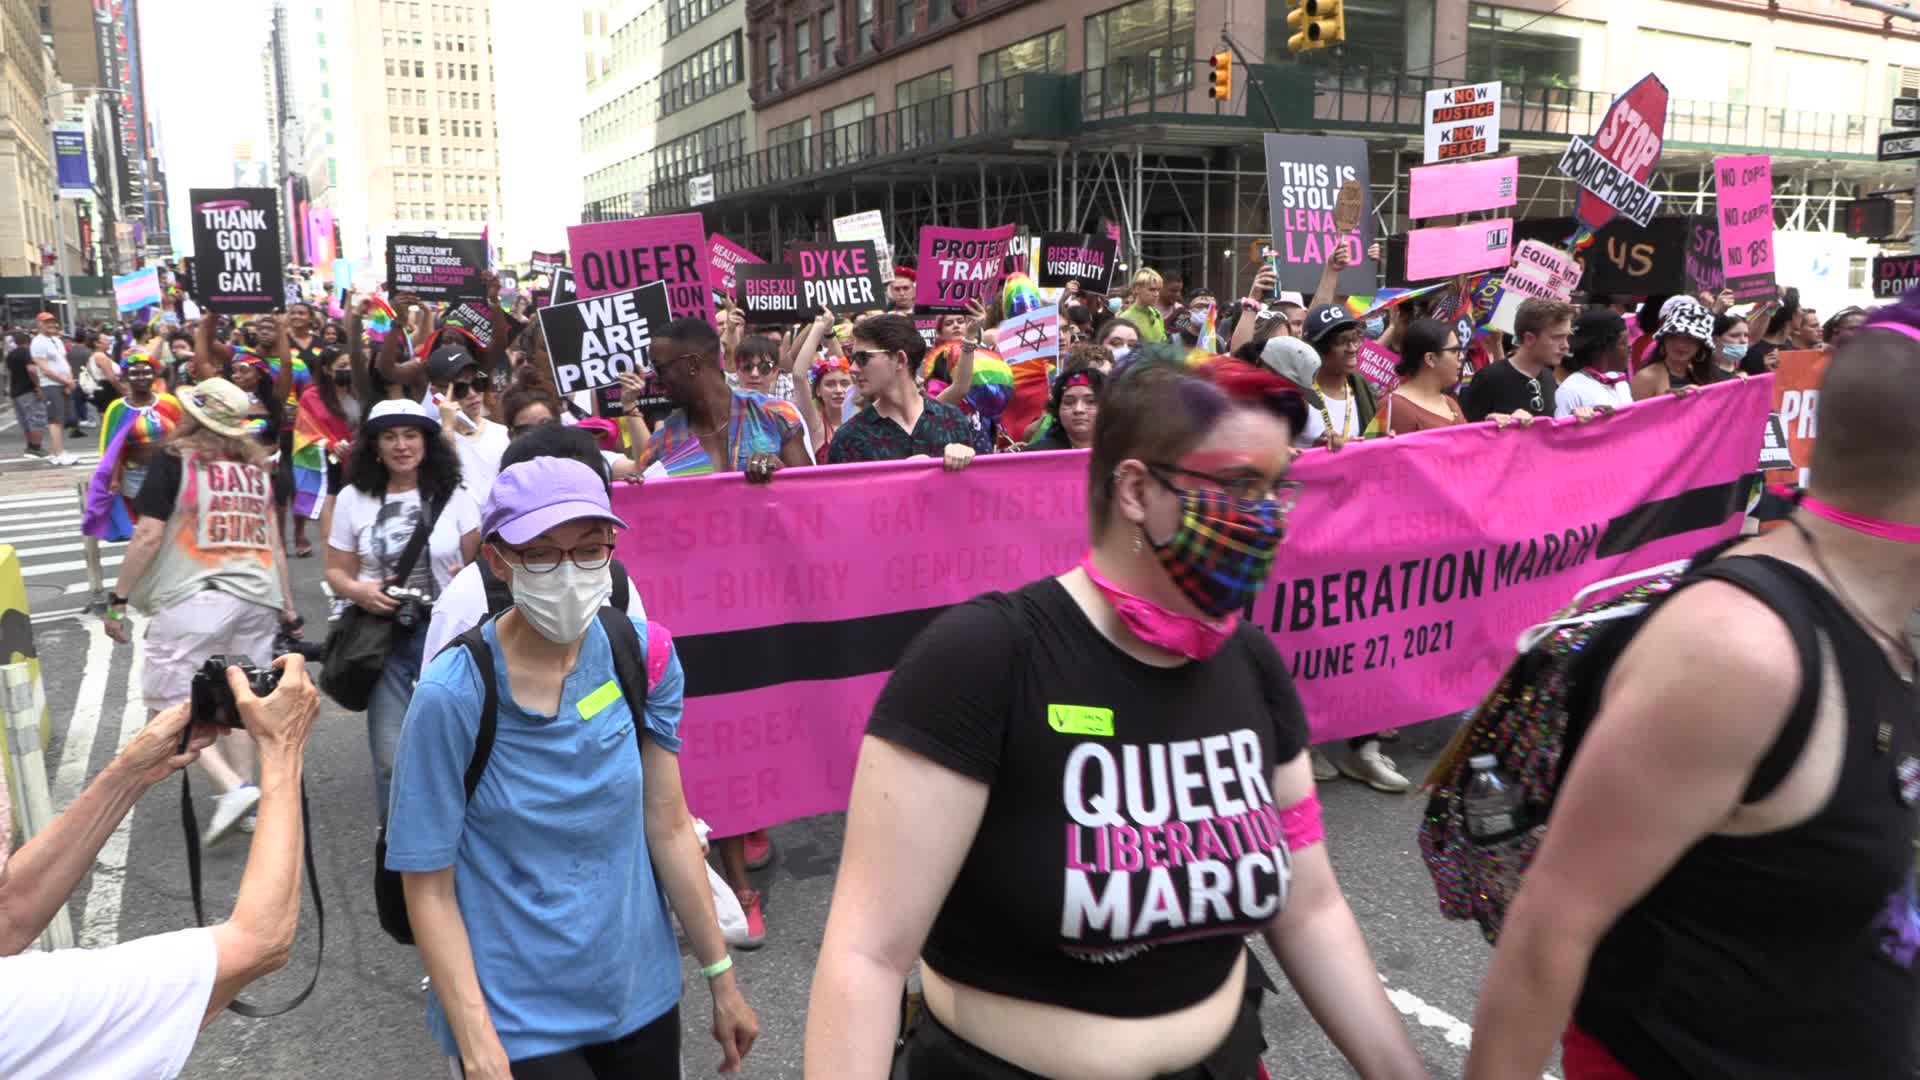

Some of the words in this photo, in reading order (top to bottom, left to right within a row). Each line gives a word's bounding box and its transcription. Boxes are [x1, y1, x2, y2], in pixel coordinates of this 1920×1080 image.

[1433, 102, 1494, 122] JUSTICE
[1439, 140, 1486, 159] PEACE
[1599, 100, 1660, 176] STOP
[1280, 162, 1329, 187] THIS
[1335, 165, 1356, 188] IS
[1561, 139, 1657, 226] HOMOPHOBIA
[1722, 168, 1736, 187] NO
[1281, 185, 1341, 210] STOL
[201, 208, 267, 229] THANK
[1724, 208, 1739, 226] NO
[216, 230, 256, 250] GOD
[224, 251, 252, 272] I'M
[582, 244, 700, 291] QUEER
[800, 248, 869, 278] DYKE
[938, 258, 1000, 280] TRANS
[1047, 247, 1105, 266] BISEXUAL
[1520, 245, 1561, 274] EQUAL
[1728, 246, 1742, 265] NO
[218, 272, 262, 292] GAY!
[1047, 261, 1105, 280] VISIBILITY
[804, 277, 875, 308] POWER
[577, 293, 640, 330] WE
[1320, 306, 1344, 323] CG
[581, 318, 652, 361] ARE
[557, 345, 656, 394] PROU
[207, 464, 265, 496] GAYS
[208, 515, 266, 543] GUNS
[634, 502, 826, 556] ESBIAN
[1495, 522, 1600, 592] MARCH
[640, 561, 850, 616] ON-BINARY
[1291, 643, 1356, 680] JUNE
[1364, 634, 1397, 670] 27,
[1403, 619, 1455, 660] 2021
[1063, 728, 1274, 828] QUEER
[1061, 840, 1292, 940] MARCH
